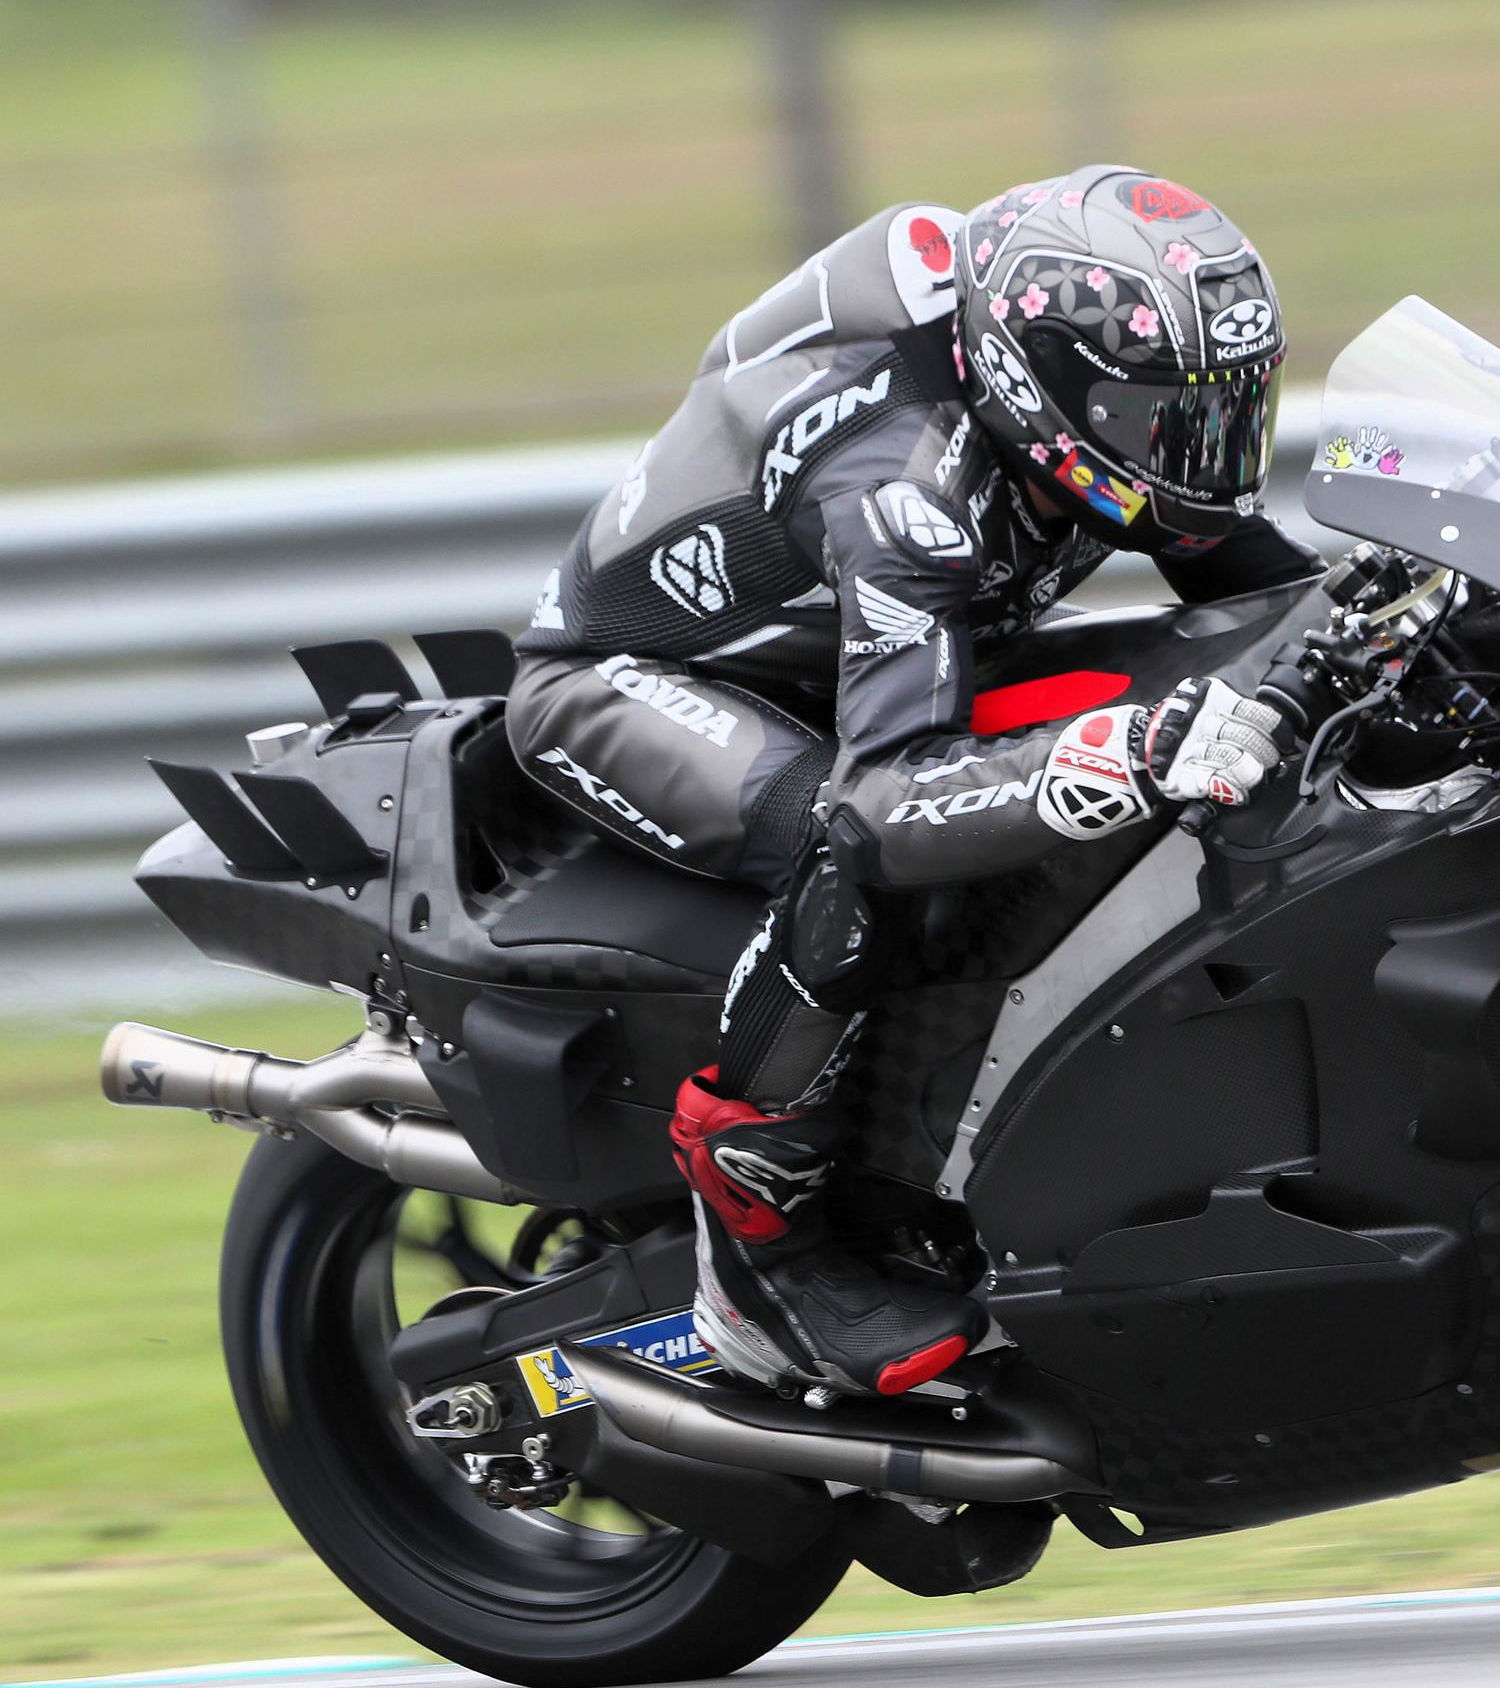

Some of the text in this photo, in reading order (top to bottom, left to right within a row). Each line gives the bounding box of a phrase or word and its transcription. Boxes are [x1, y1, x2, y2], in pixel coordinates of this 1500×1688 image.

[1073, 341, 1128, 380] Kabuto
[1216, 335, 1275, 361] Kabuto
[762, 368, 891, 513] IXON
[934, 412, 971, 487] IXON
[535, 746, 687, 850] IXON
[884, 769, 1044, 825] IXON
